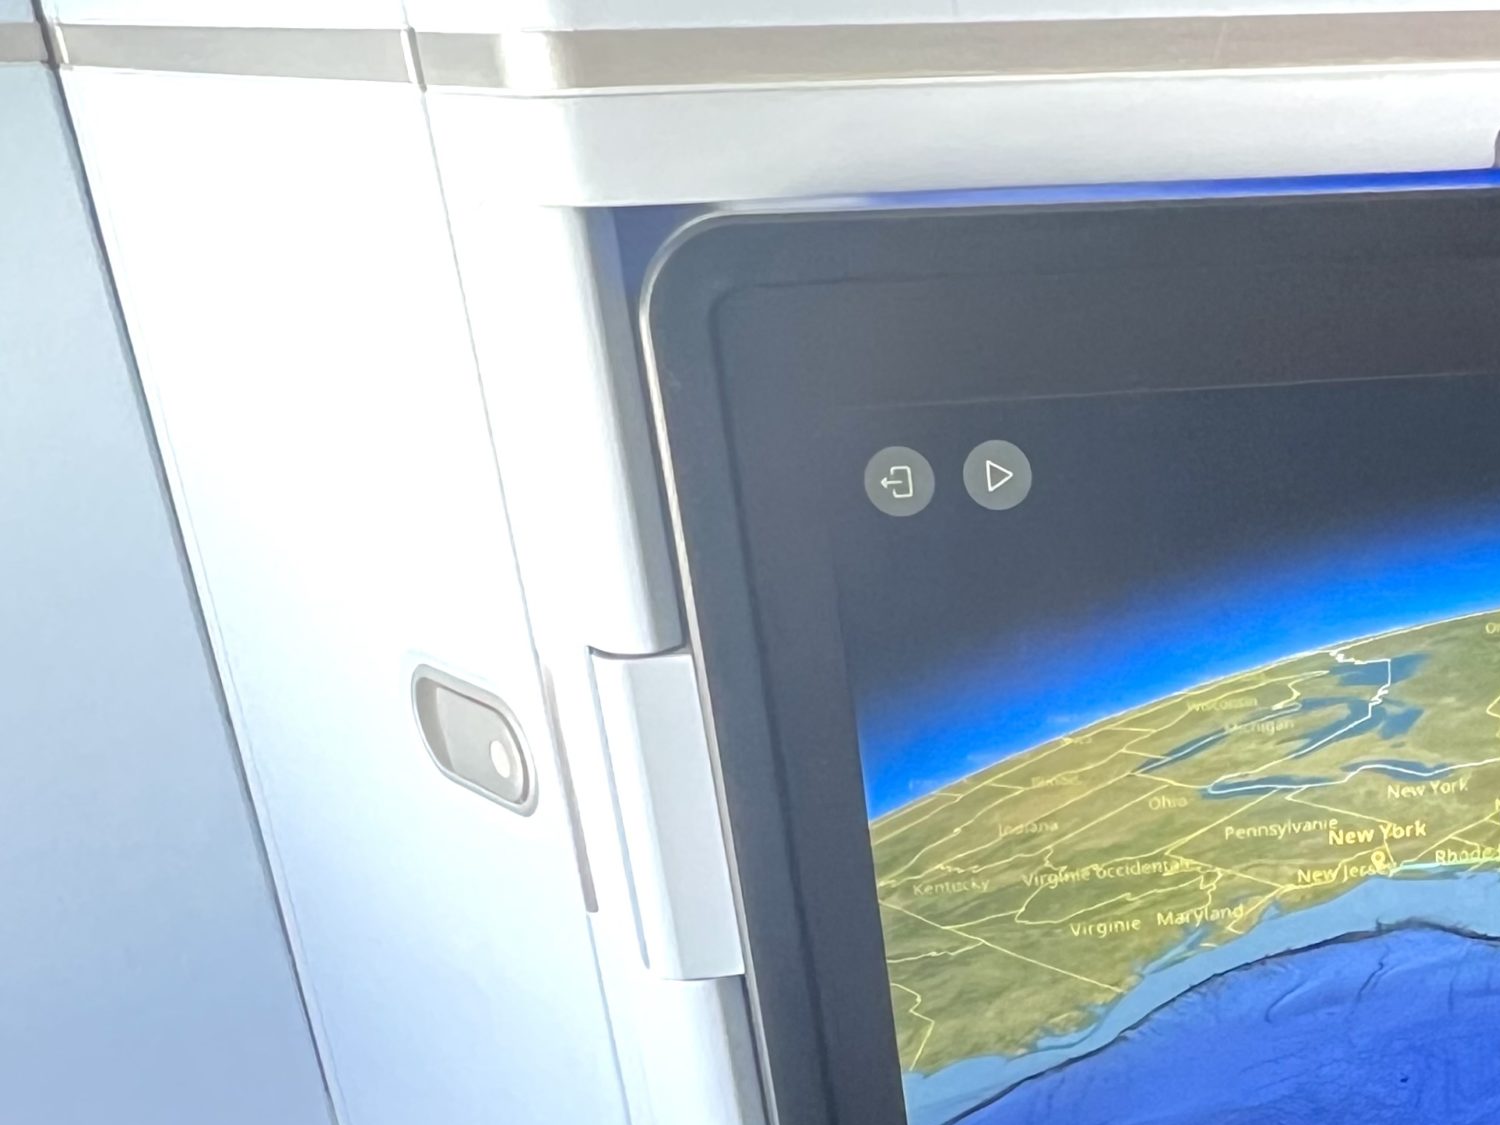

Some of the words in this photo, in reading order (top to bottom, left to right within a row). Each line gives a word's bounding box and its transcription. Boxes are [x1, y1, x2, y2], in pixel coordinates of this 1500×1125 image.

[1386, 784, 1425, 799] New
[1428, 778, 1469, 796] York
[1148, 795, 1188, 811] Ohio
[1224, 818, 1338, 841] Pennsylvanie
[1328, 827, 1374, 846] New
[1379, 821, 1427, 841] York
[1435, 846, 1494, 865] Rhode
[1021, 868, 1091, 889] Virginie
[1297, 867, 1337, 883] New
[912, 878, 990, 897] Kentucky
[1069, 918, 1142, 937] Virginie
[1156, 903, 1244, 928] Maryland
